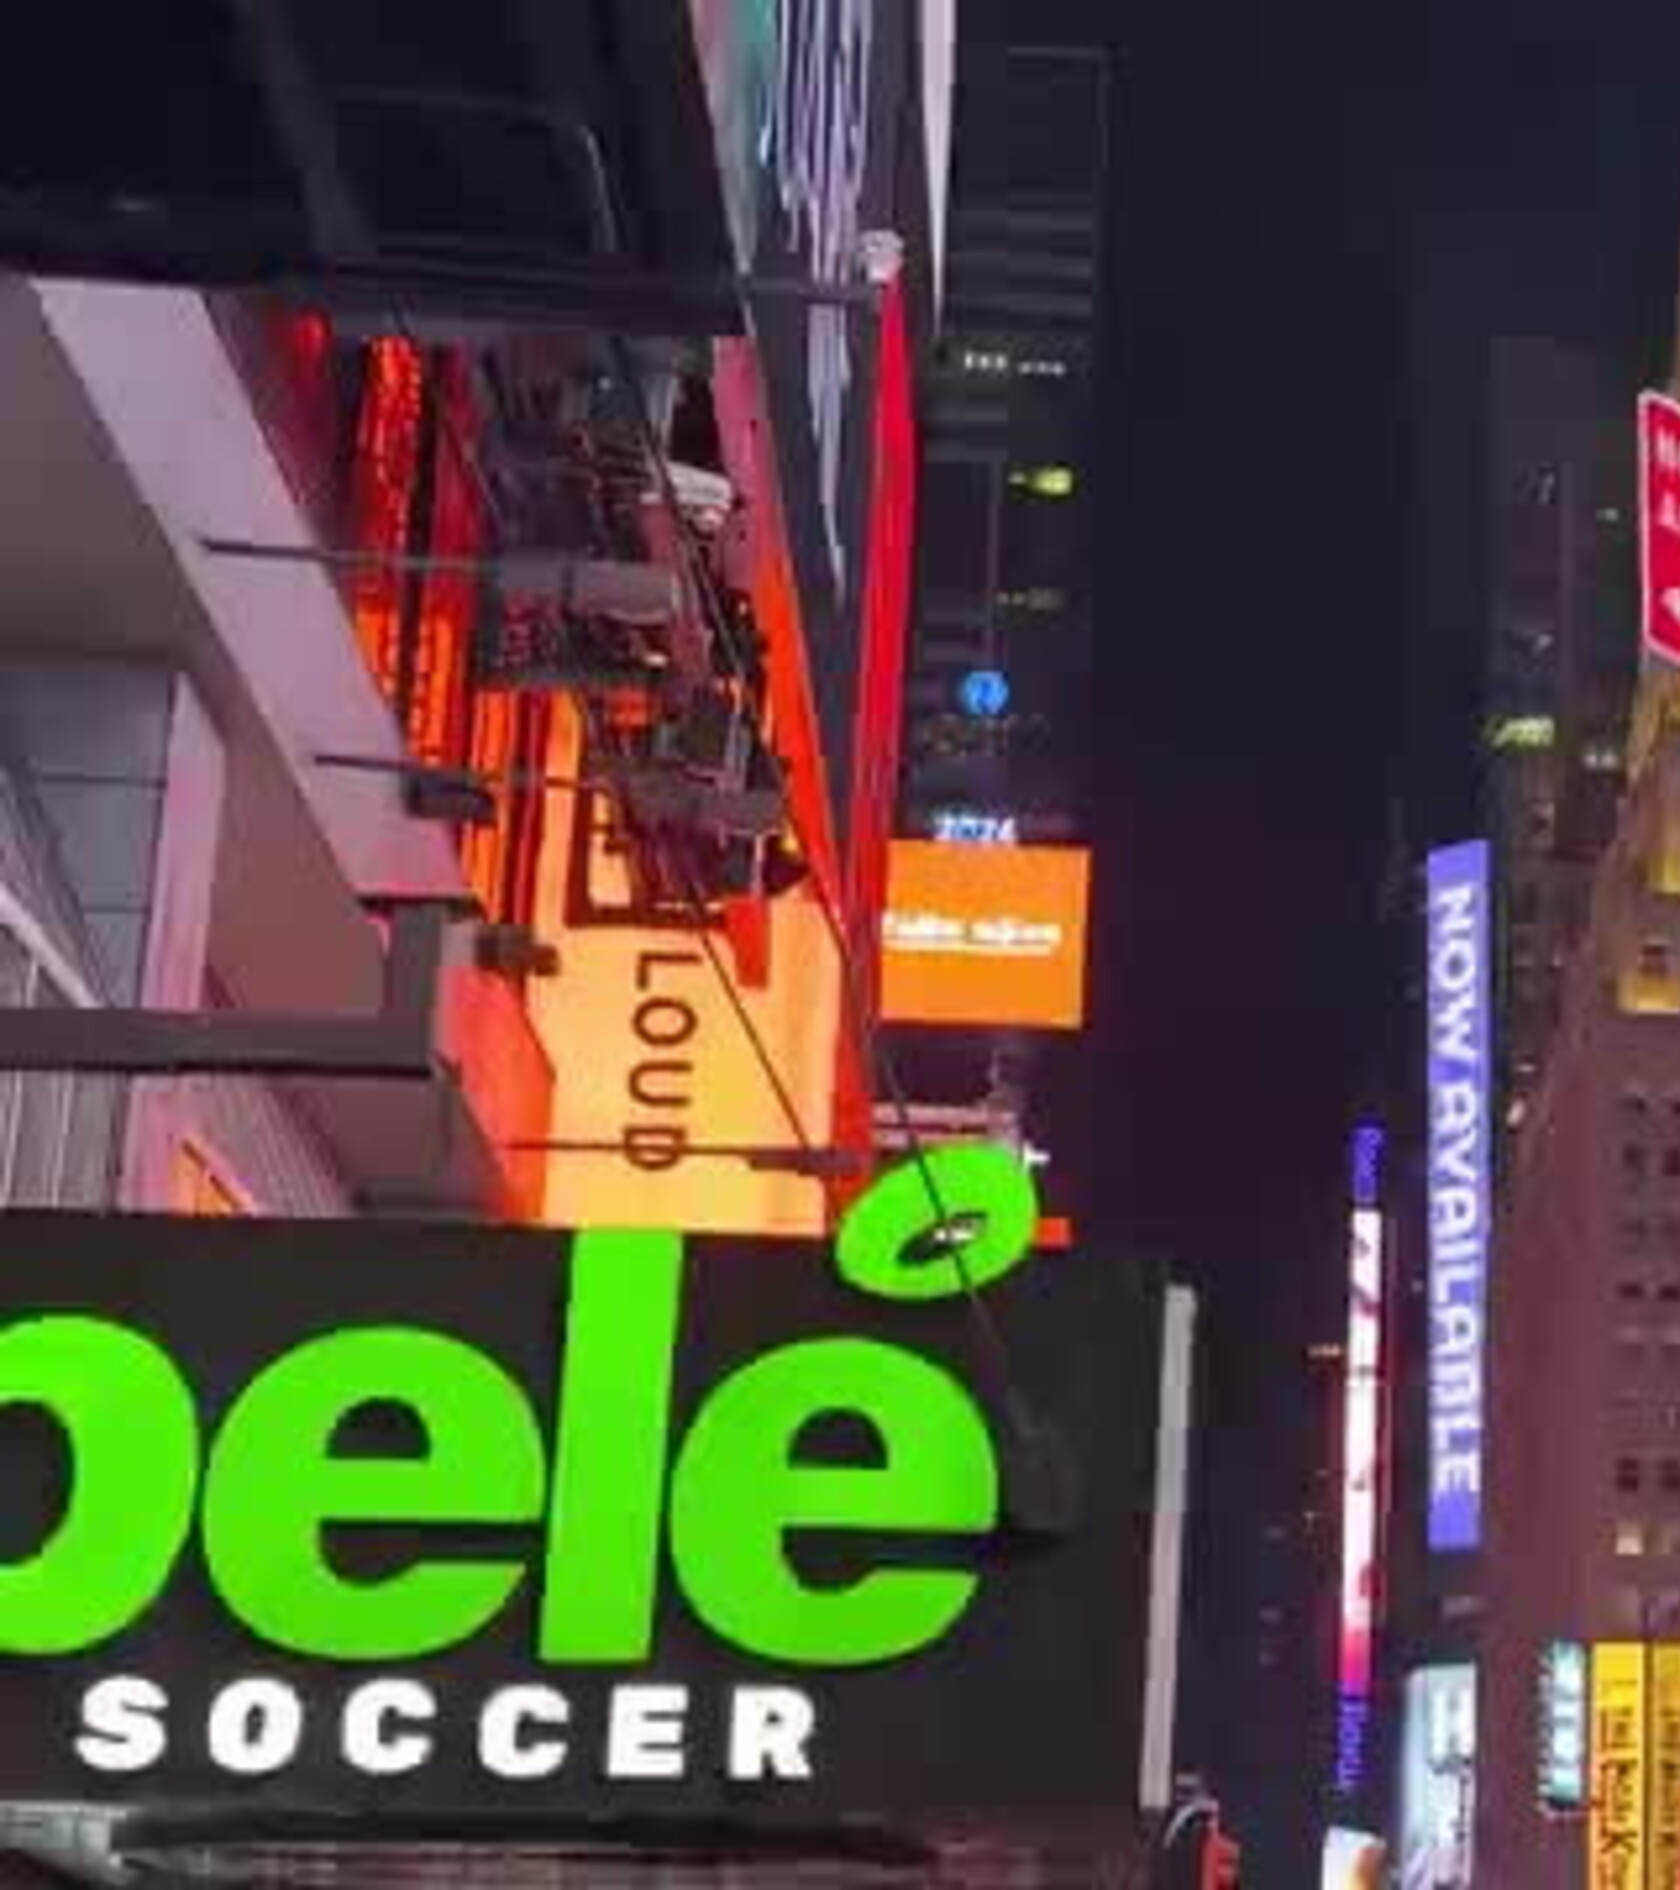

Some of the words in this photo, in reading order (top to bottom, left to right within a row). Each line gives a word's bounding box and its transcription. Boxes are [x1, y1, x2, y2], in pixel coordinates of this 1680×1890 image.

[622, 951, 704, 1171] LOUD
[1436, 886, 1477, 1056] NOW
[1430, 1084, 1481, 1494] AVAILABLE
[75, 1676, 818, 1779] SOCCER
